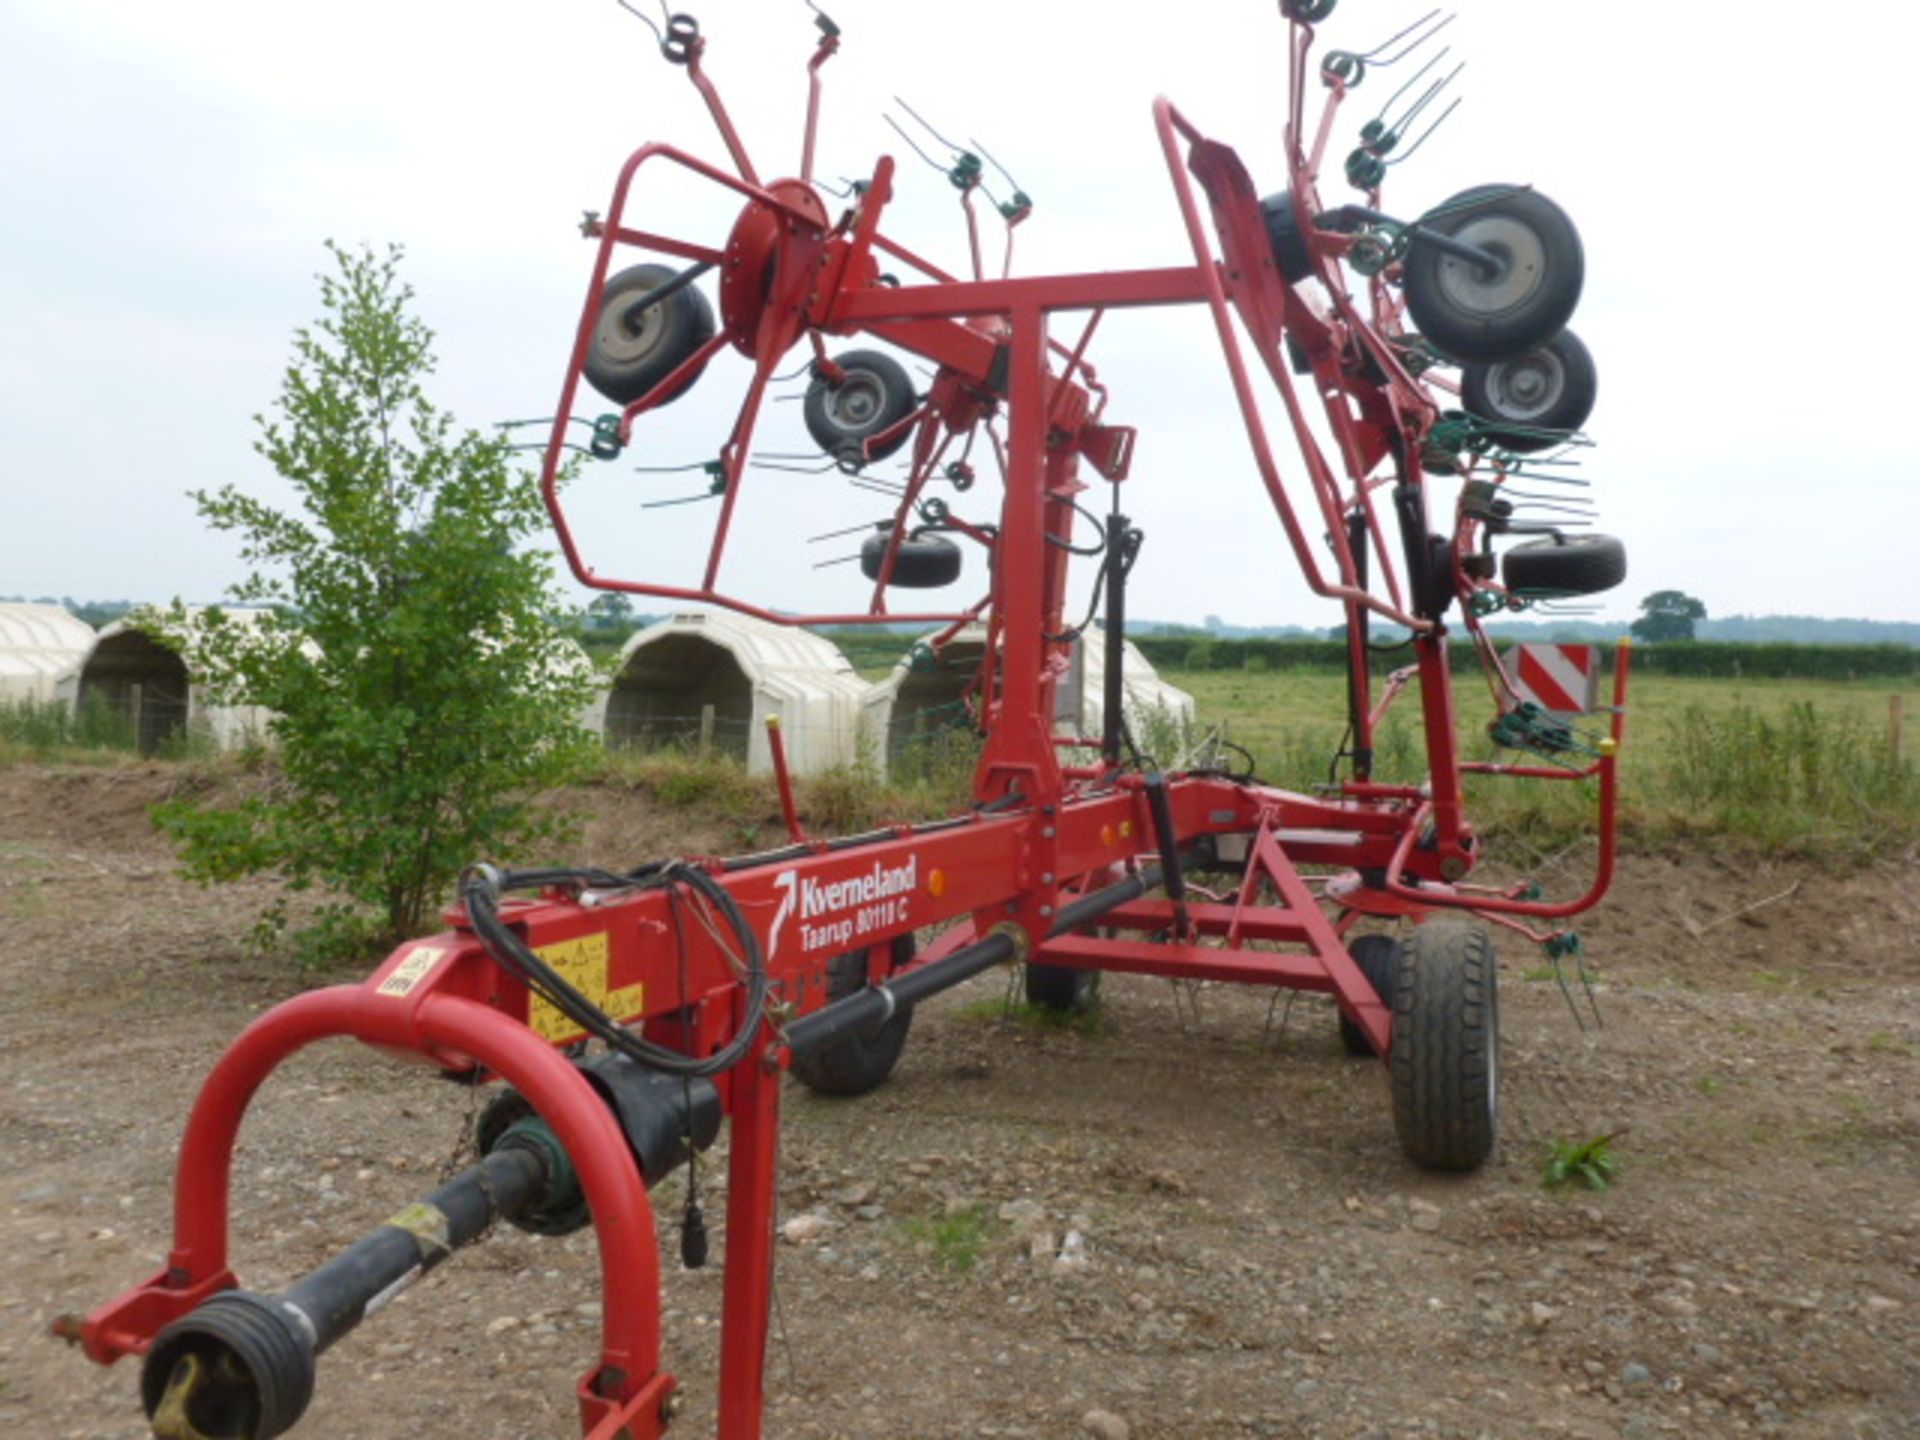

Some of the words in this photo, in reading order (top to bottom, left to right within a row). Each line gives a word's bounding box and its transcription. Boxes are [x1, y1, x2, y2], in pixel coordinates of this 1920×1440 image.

[801, 853, 917, 919] Kverneland
[801, 920, 852, 951] Taarup
[897, 896, 909, 921] C
